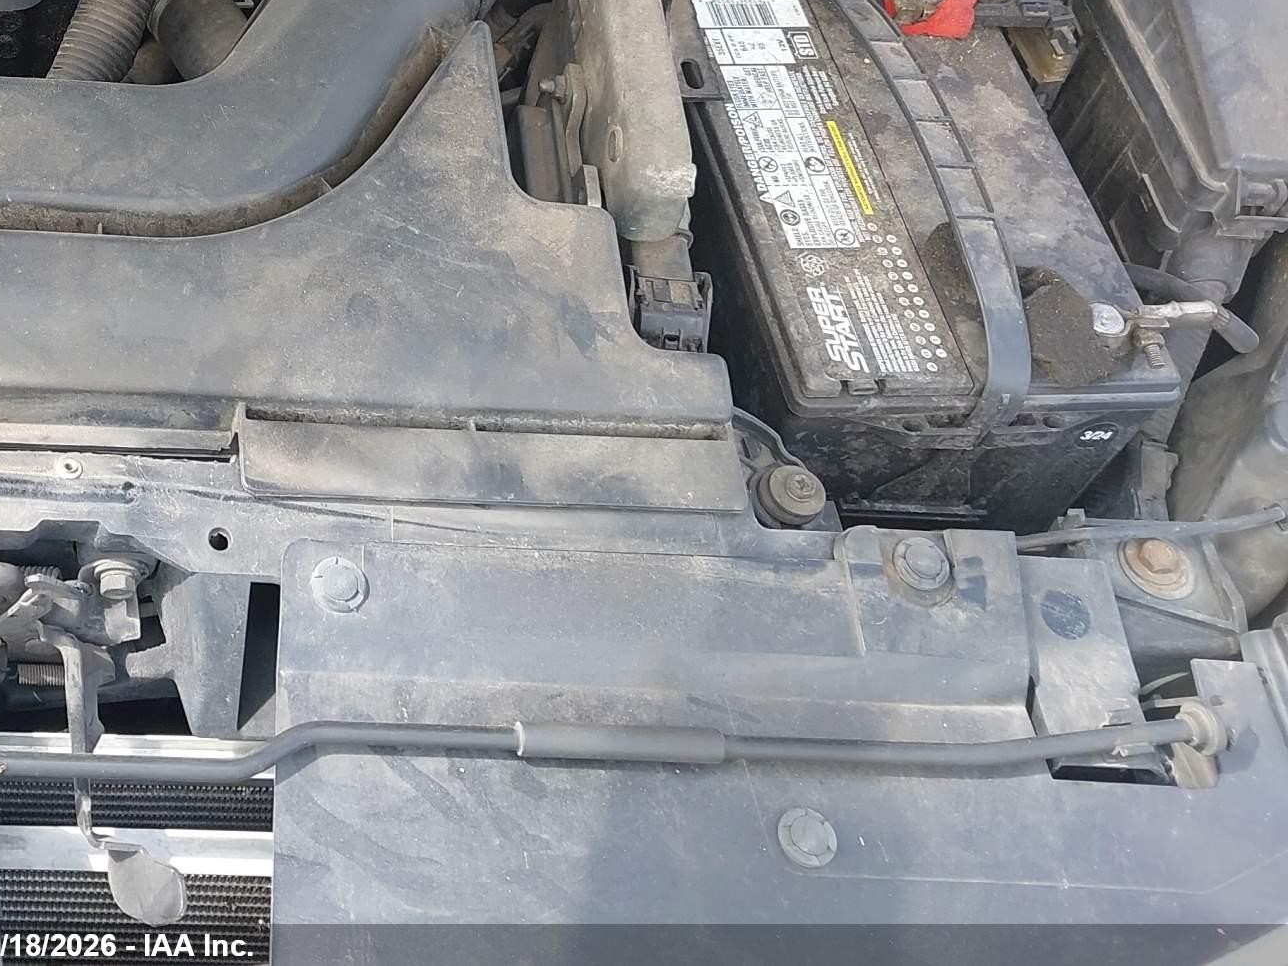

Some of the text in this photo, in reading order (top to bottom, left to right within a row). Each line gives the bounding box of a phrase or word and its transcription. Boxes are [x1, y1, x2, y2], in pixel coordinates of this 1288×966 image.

[775, 38, 787, 51] 12V
[792, 34, 815, 56] STD
[724, 103, 768, 192] DANGER/POISON
[806, 286, 842, 362] SUPER
[821, 286, 870, 373] START
[1079, 430, 1113, 440] 3/24
